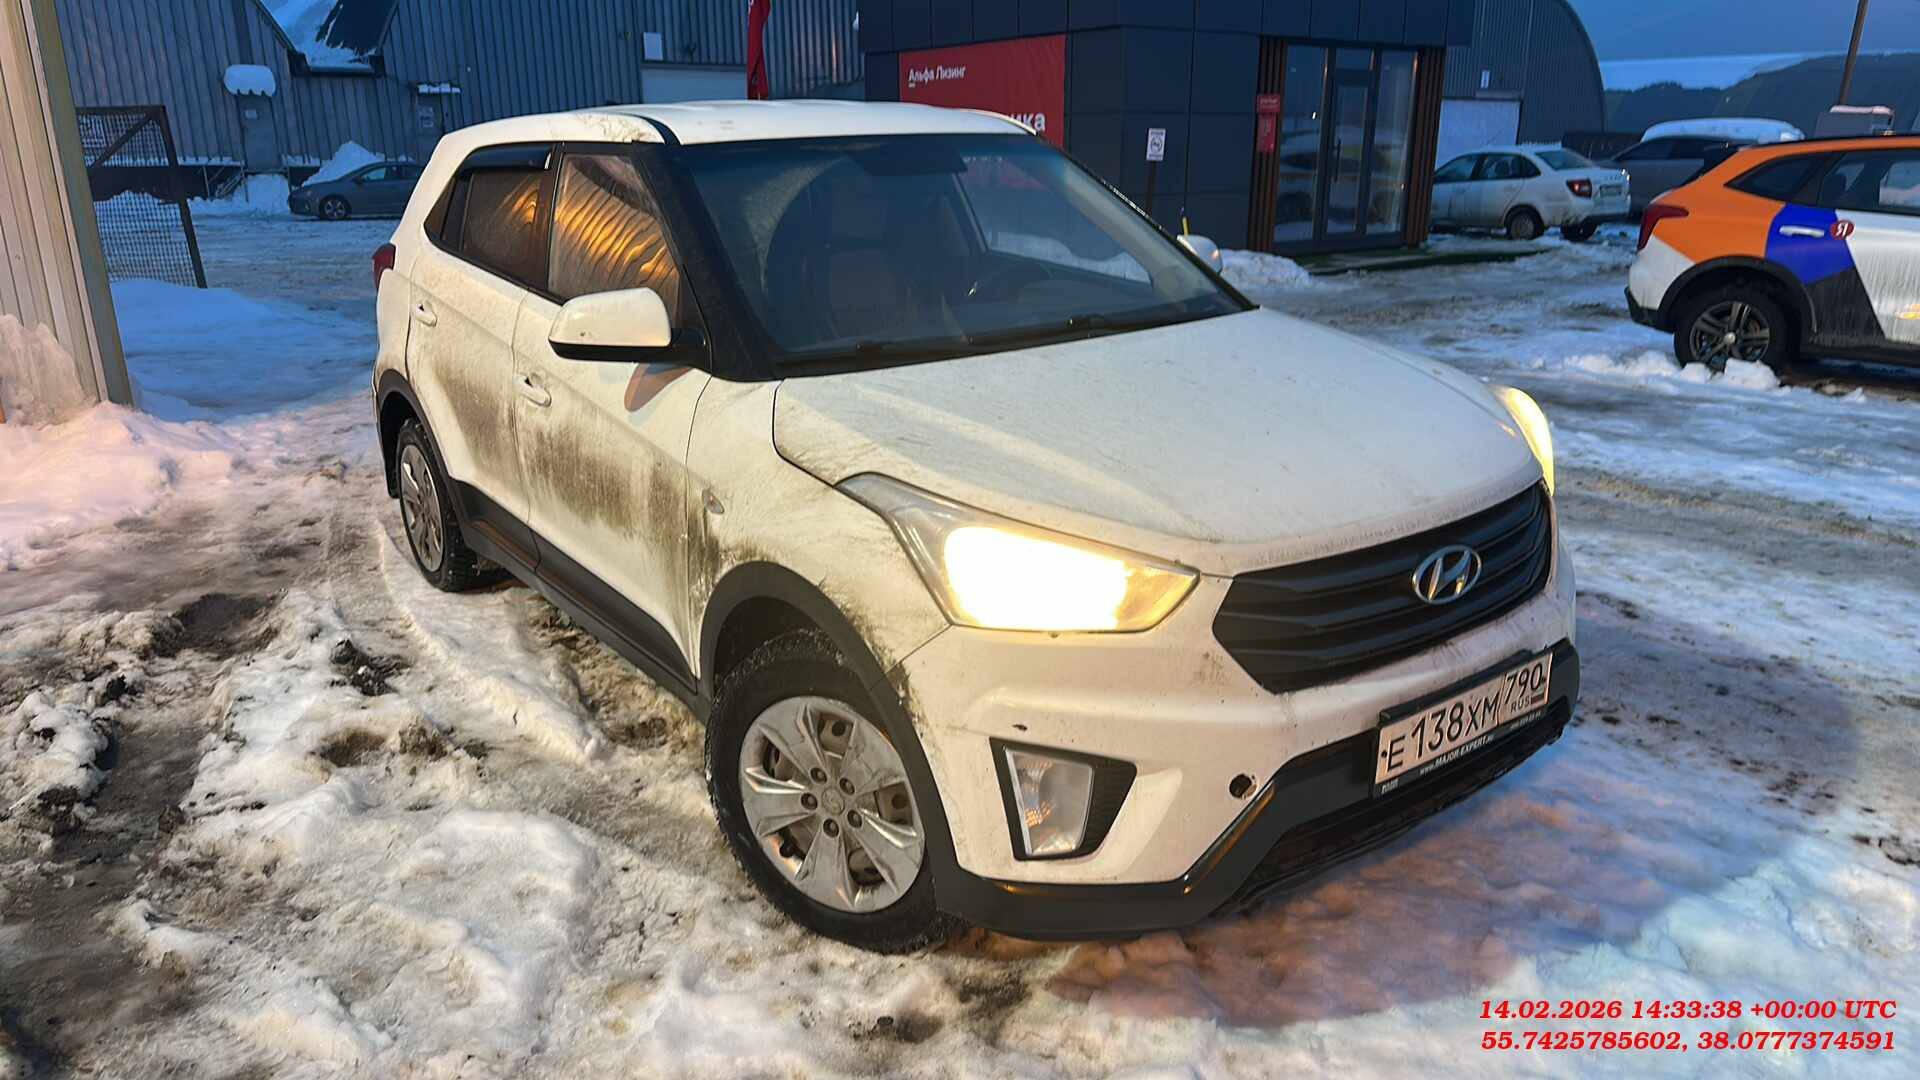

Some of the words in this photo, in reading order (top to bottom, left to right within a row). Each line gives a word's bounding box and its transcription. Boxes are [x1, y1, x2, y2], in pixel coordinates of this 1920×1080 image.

[908, 68, 935, 85] Альфа
[936, 65, 966, 81] Лизинг
[1504, 662, 1544, 704] 790
[1510, 697, 1531, 713] RUS
